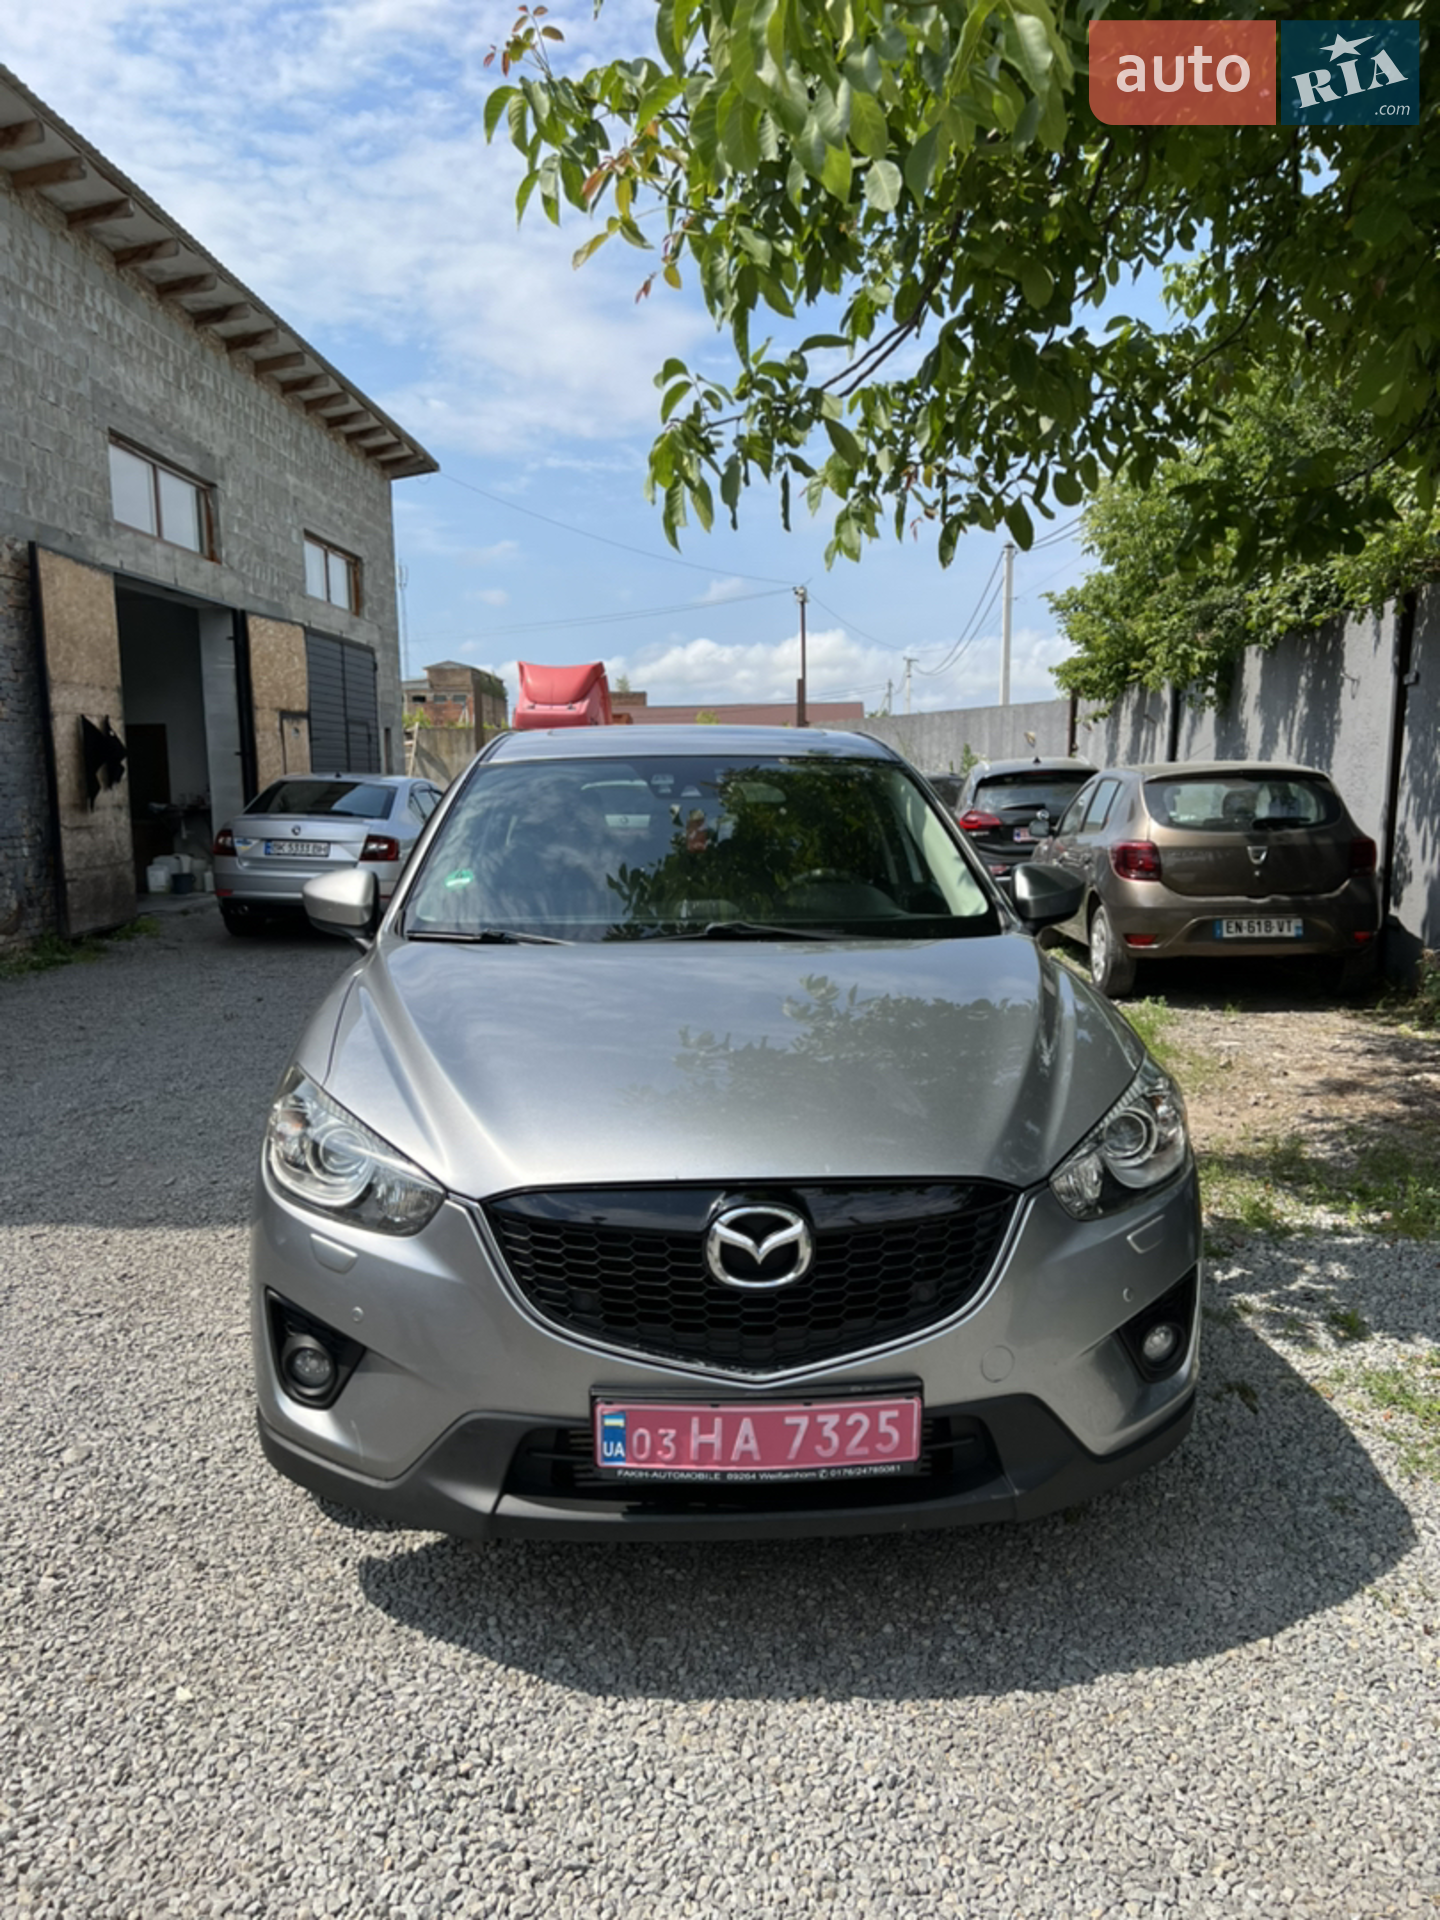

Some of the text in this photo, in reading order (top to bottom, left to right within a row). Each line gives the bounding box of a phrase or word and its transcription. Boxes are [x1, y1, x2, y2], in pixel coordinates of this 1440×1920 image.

[602, 1441, 626, 1458] UA
[632, 1410, 900, 1462] 03 HA 7325
